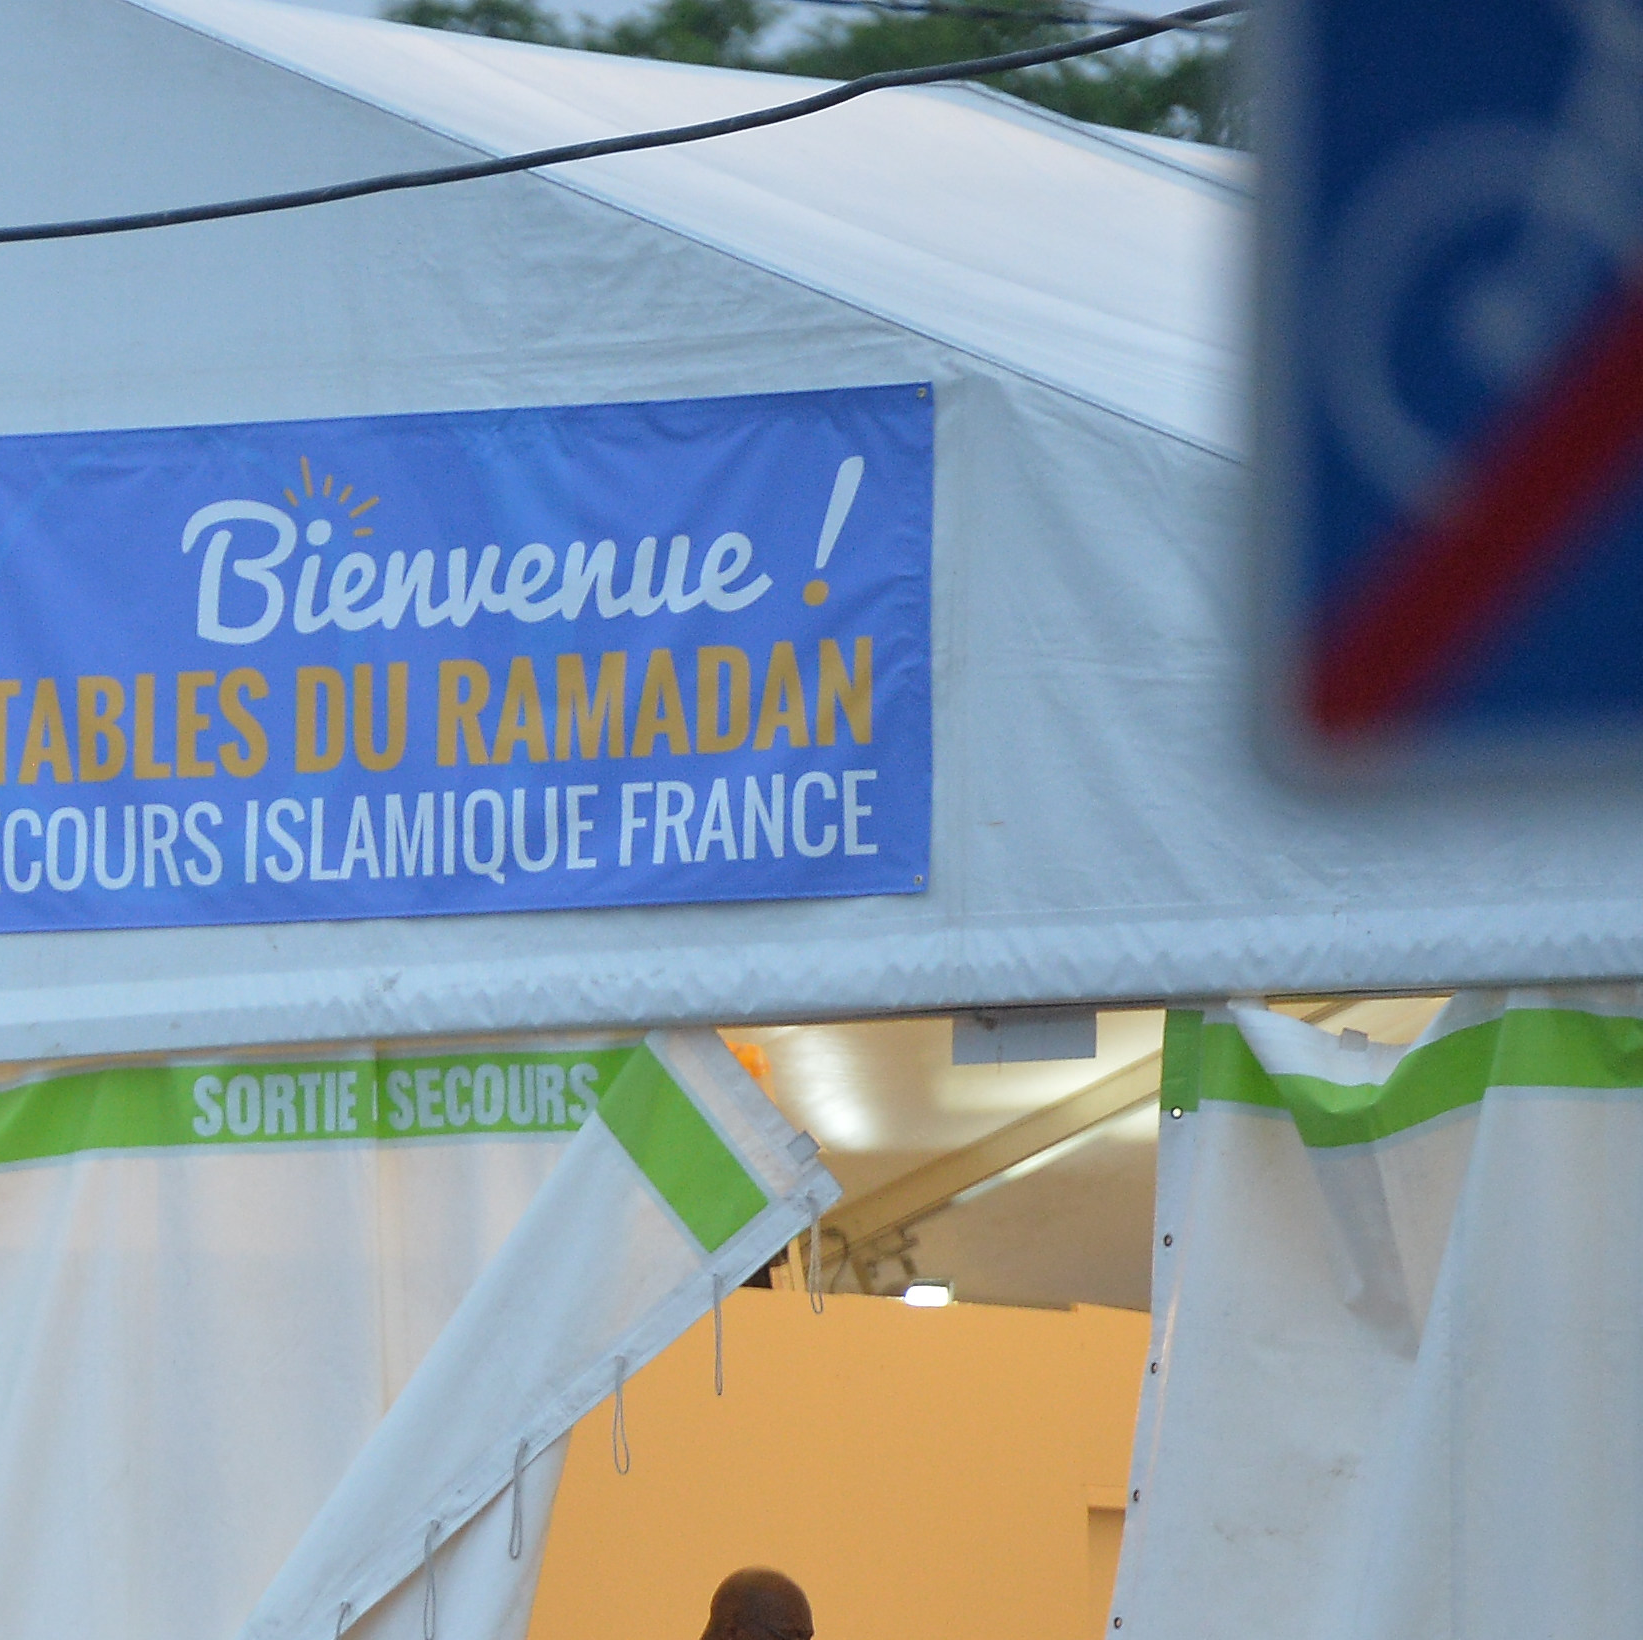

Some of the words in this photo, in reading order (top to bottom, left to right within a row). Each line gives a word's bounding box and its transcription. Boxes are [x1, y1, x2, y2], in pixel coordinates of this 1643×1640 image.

[180, 498, 775, 646] Bienvenue
[293, 660, 409, 775] DU
[435, 635, 874, 768] RAMADAN
[244, 784, 600, 885] ISLAMIQUE
[618, 769, 879, 868] FRANCE
[192, 1070, 358, 1138] SORTIE
[385, 1061, 601, 1132] SECOURS
